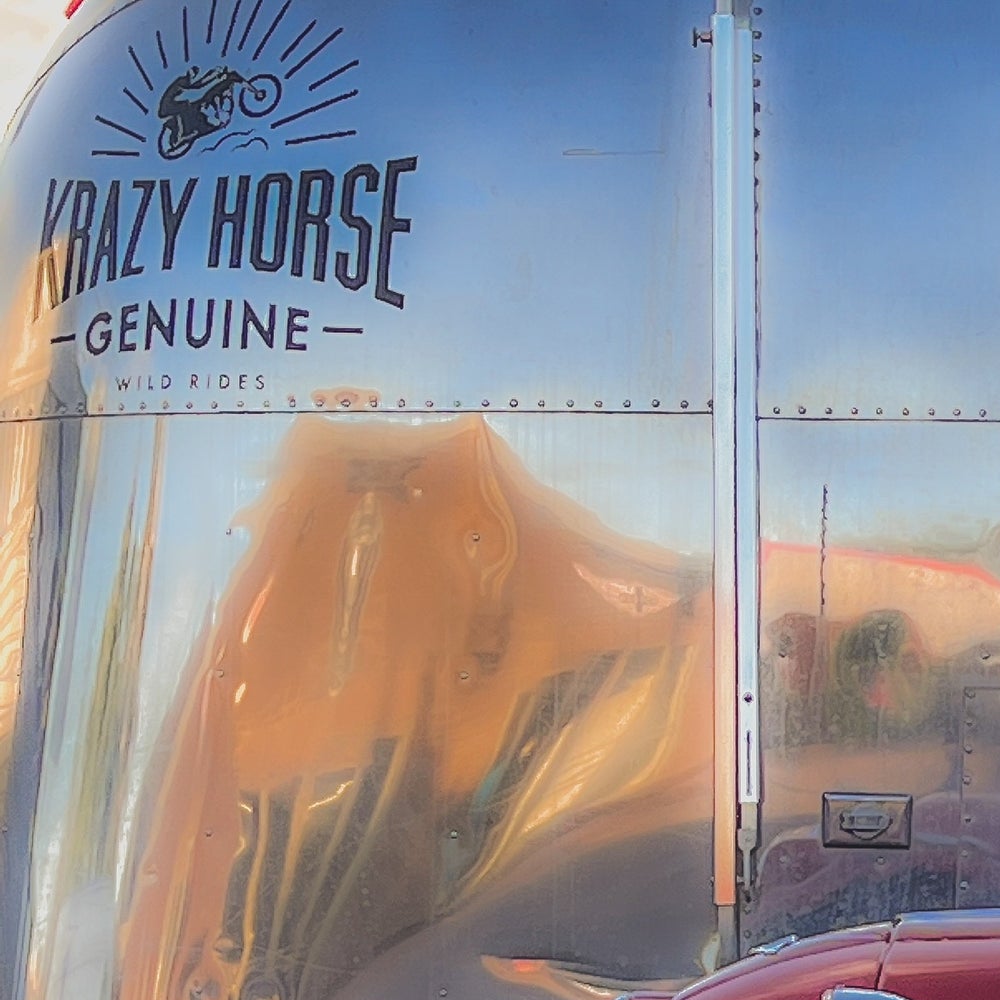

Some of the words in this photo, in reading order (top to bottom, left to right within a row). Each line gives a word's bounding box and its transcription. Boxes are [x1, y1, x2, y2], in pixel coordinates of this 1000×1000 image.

[32, 178, 199, 322] KRAZY
[207, 156, 418, 309] HORSE
[86, 299, 309, 356] GENUINE
[115, 375, 171, 390] WILD
[189, 375, 265, 390] RIDES
